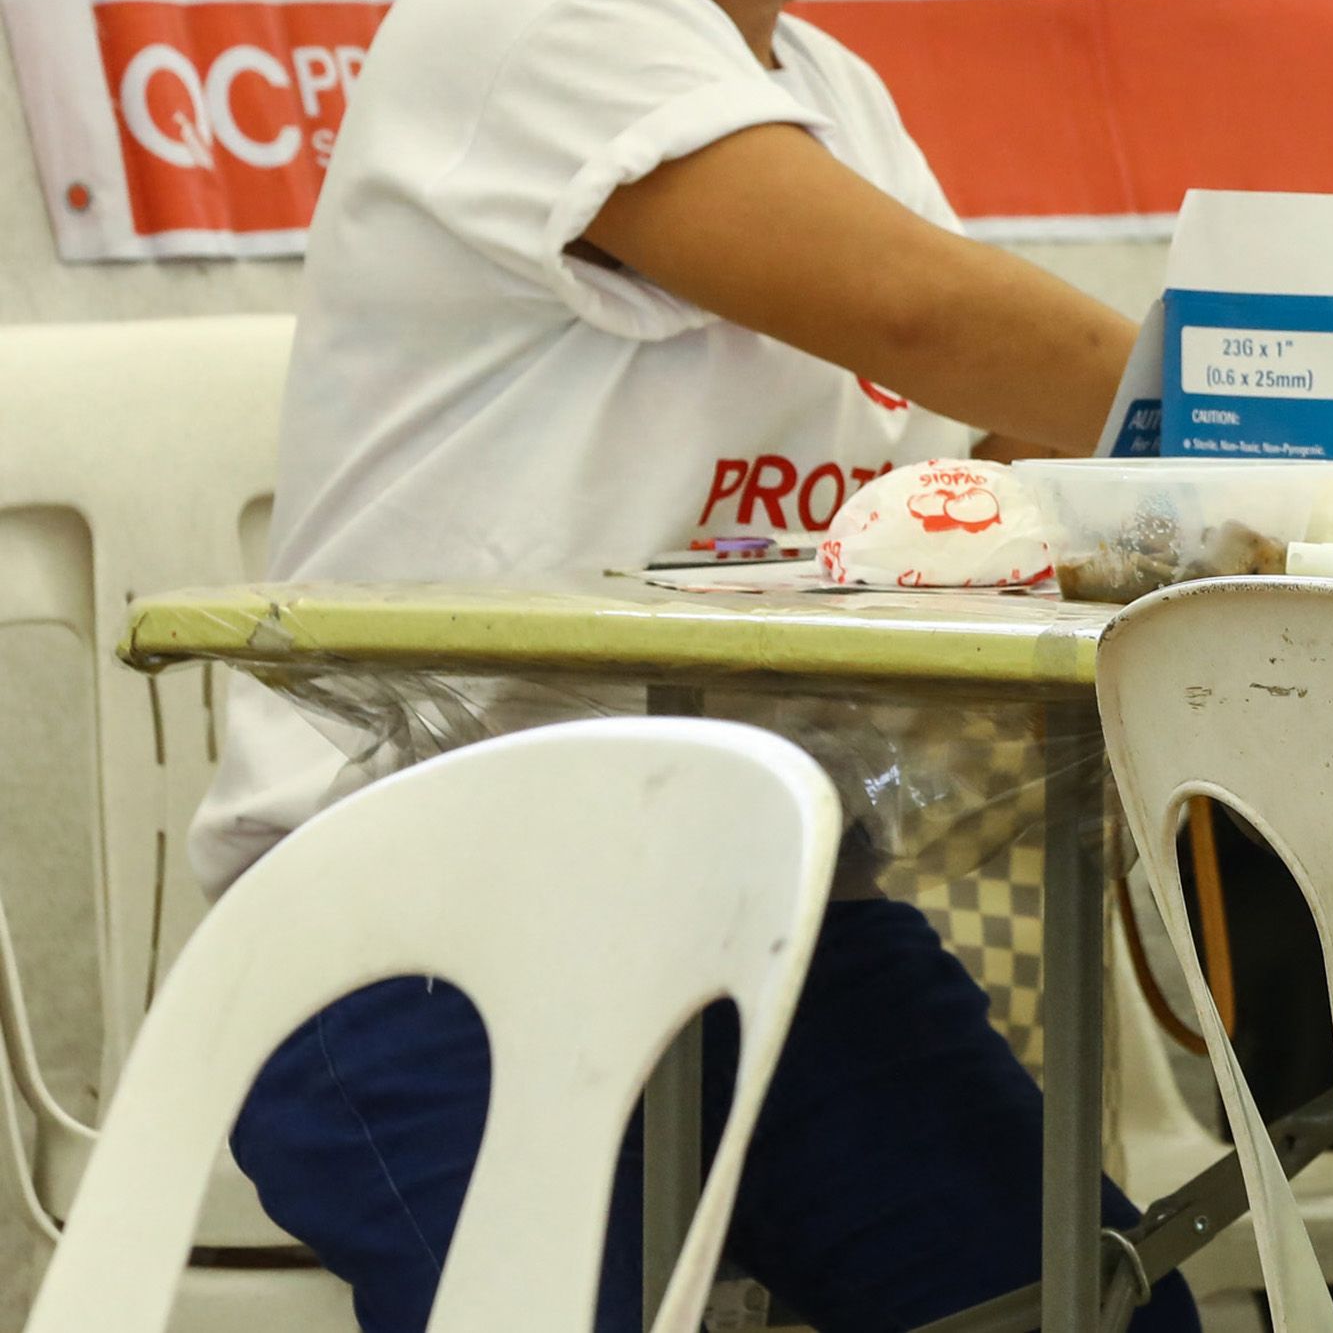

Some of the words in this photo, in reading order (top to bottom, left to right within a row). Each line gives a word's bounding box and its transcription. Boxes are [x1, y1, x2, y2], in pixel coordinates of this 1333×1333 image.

[1221, 338, 1254, 358] 23G
[1258, 343, 1269, 358] x
[1205, 365, 1236, 388] (0.6
[1240, 372, 1250, 387] x
[1255, 368, 1314, 392] 25mm)
